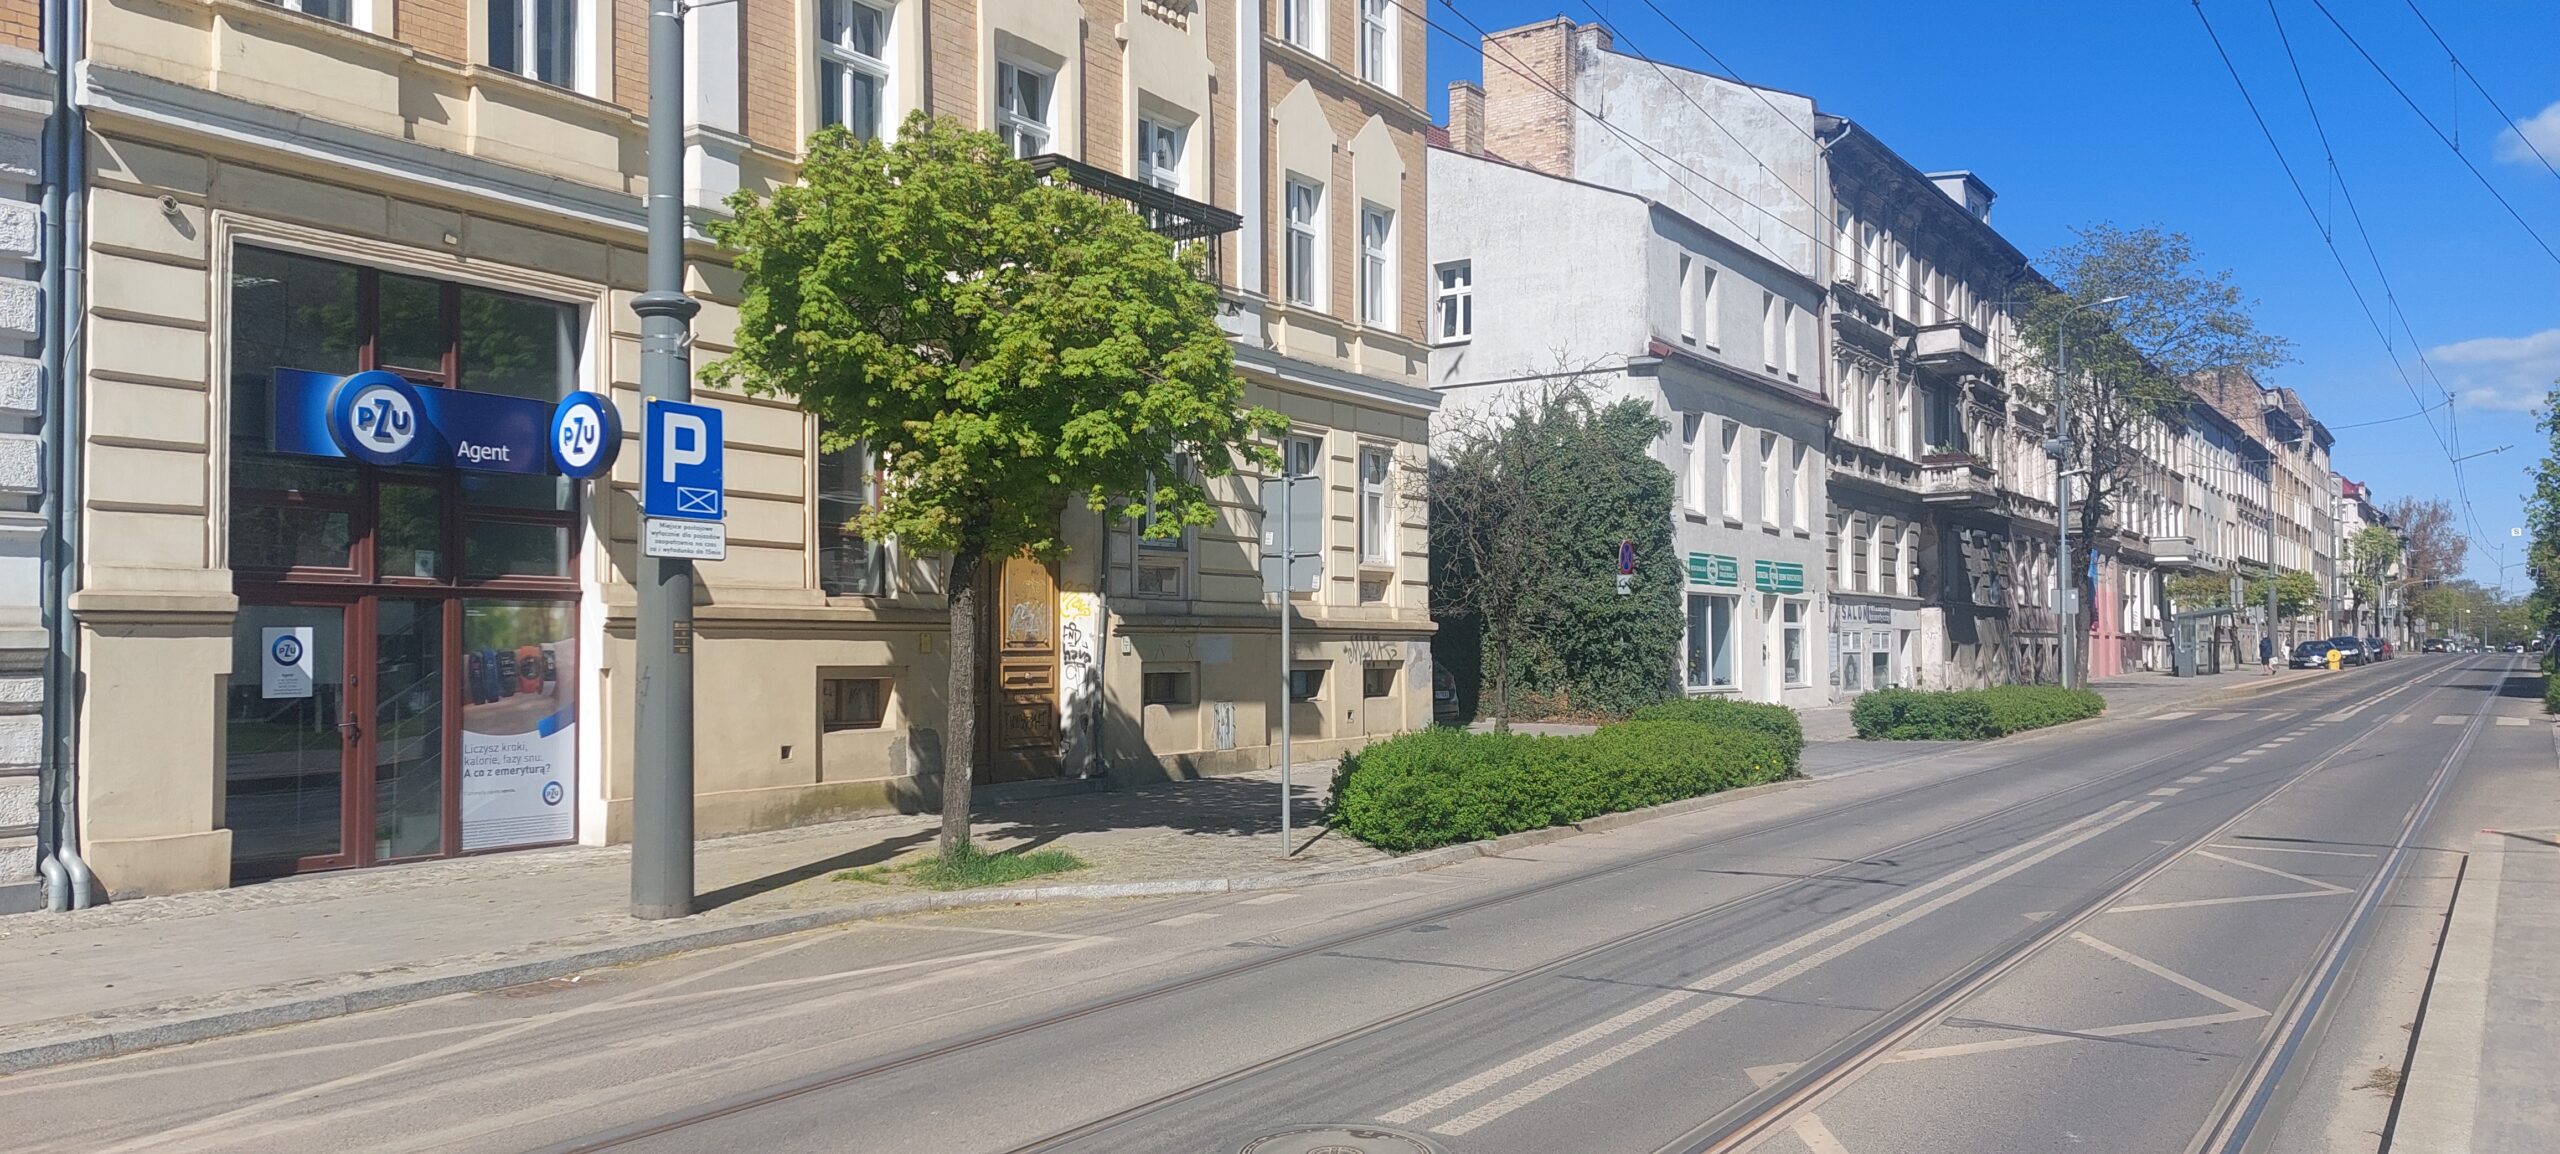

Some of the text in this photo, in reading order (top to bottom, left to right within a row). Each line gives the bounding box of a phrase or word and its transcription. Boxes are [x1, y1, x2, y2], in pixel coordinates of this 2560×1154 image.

[357, 398, 411, 443] PZU
[563, 416, 596, 456] PZU
[457, 440, 511, 463] Agent
[662, 411, 707, 483] P
[1841, 605, 1869, 621] SALON
[279, 644, 296, 657] PZU
[464, 742, 528, 755] Liczysz kroki,
[464, 768, 471, 778] A
[473, 769, 484, 777] co
[494, 763, 551, 776] emeryturą?
